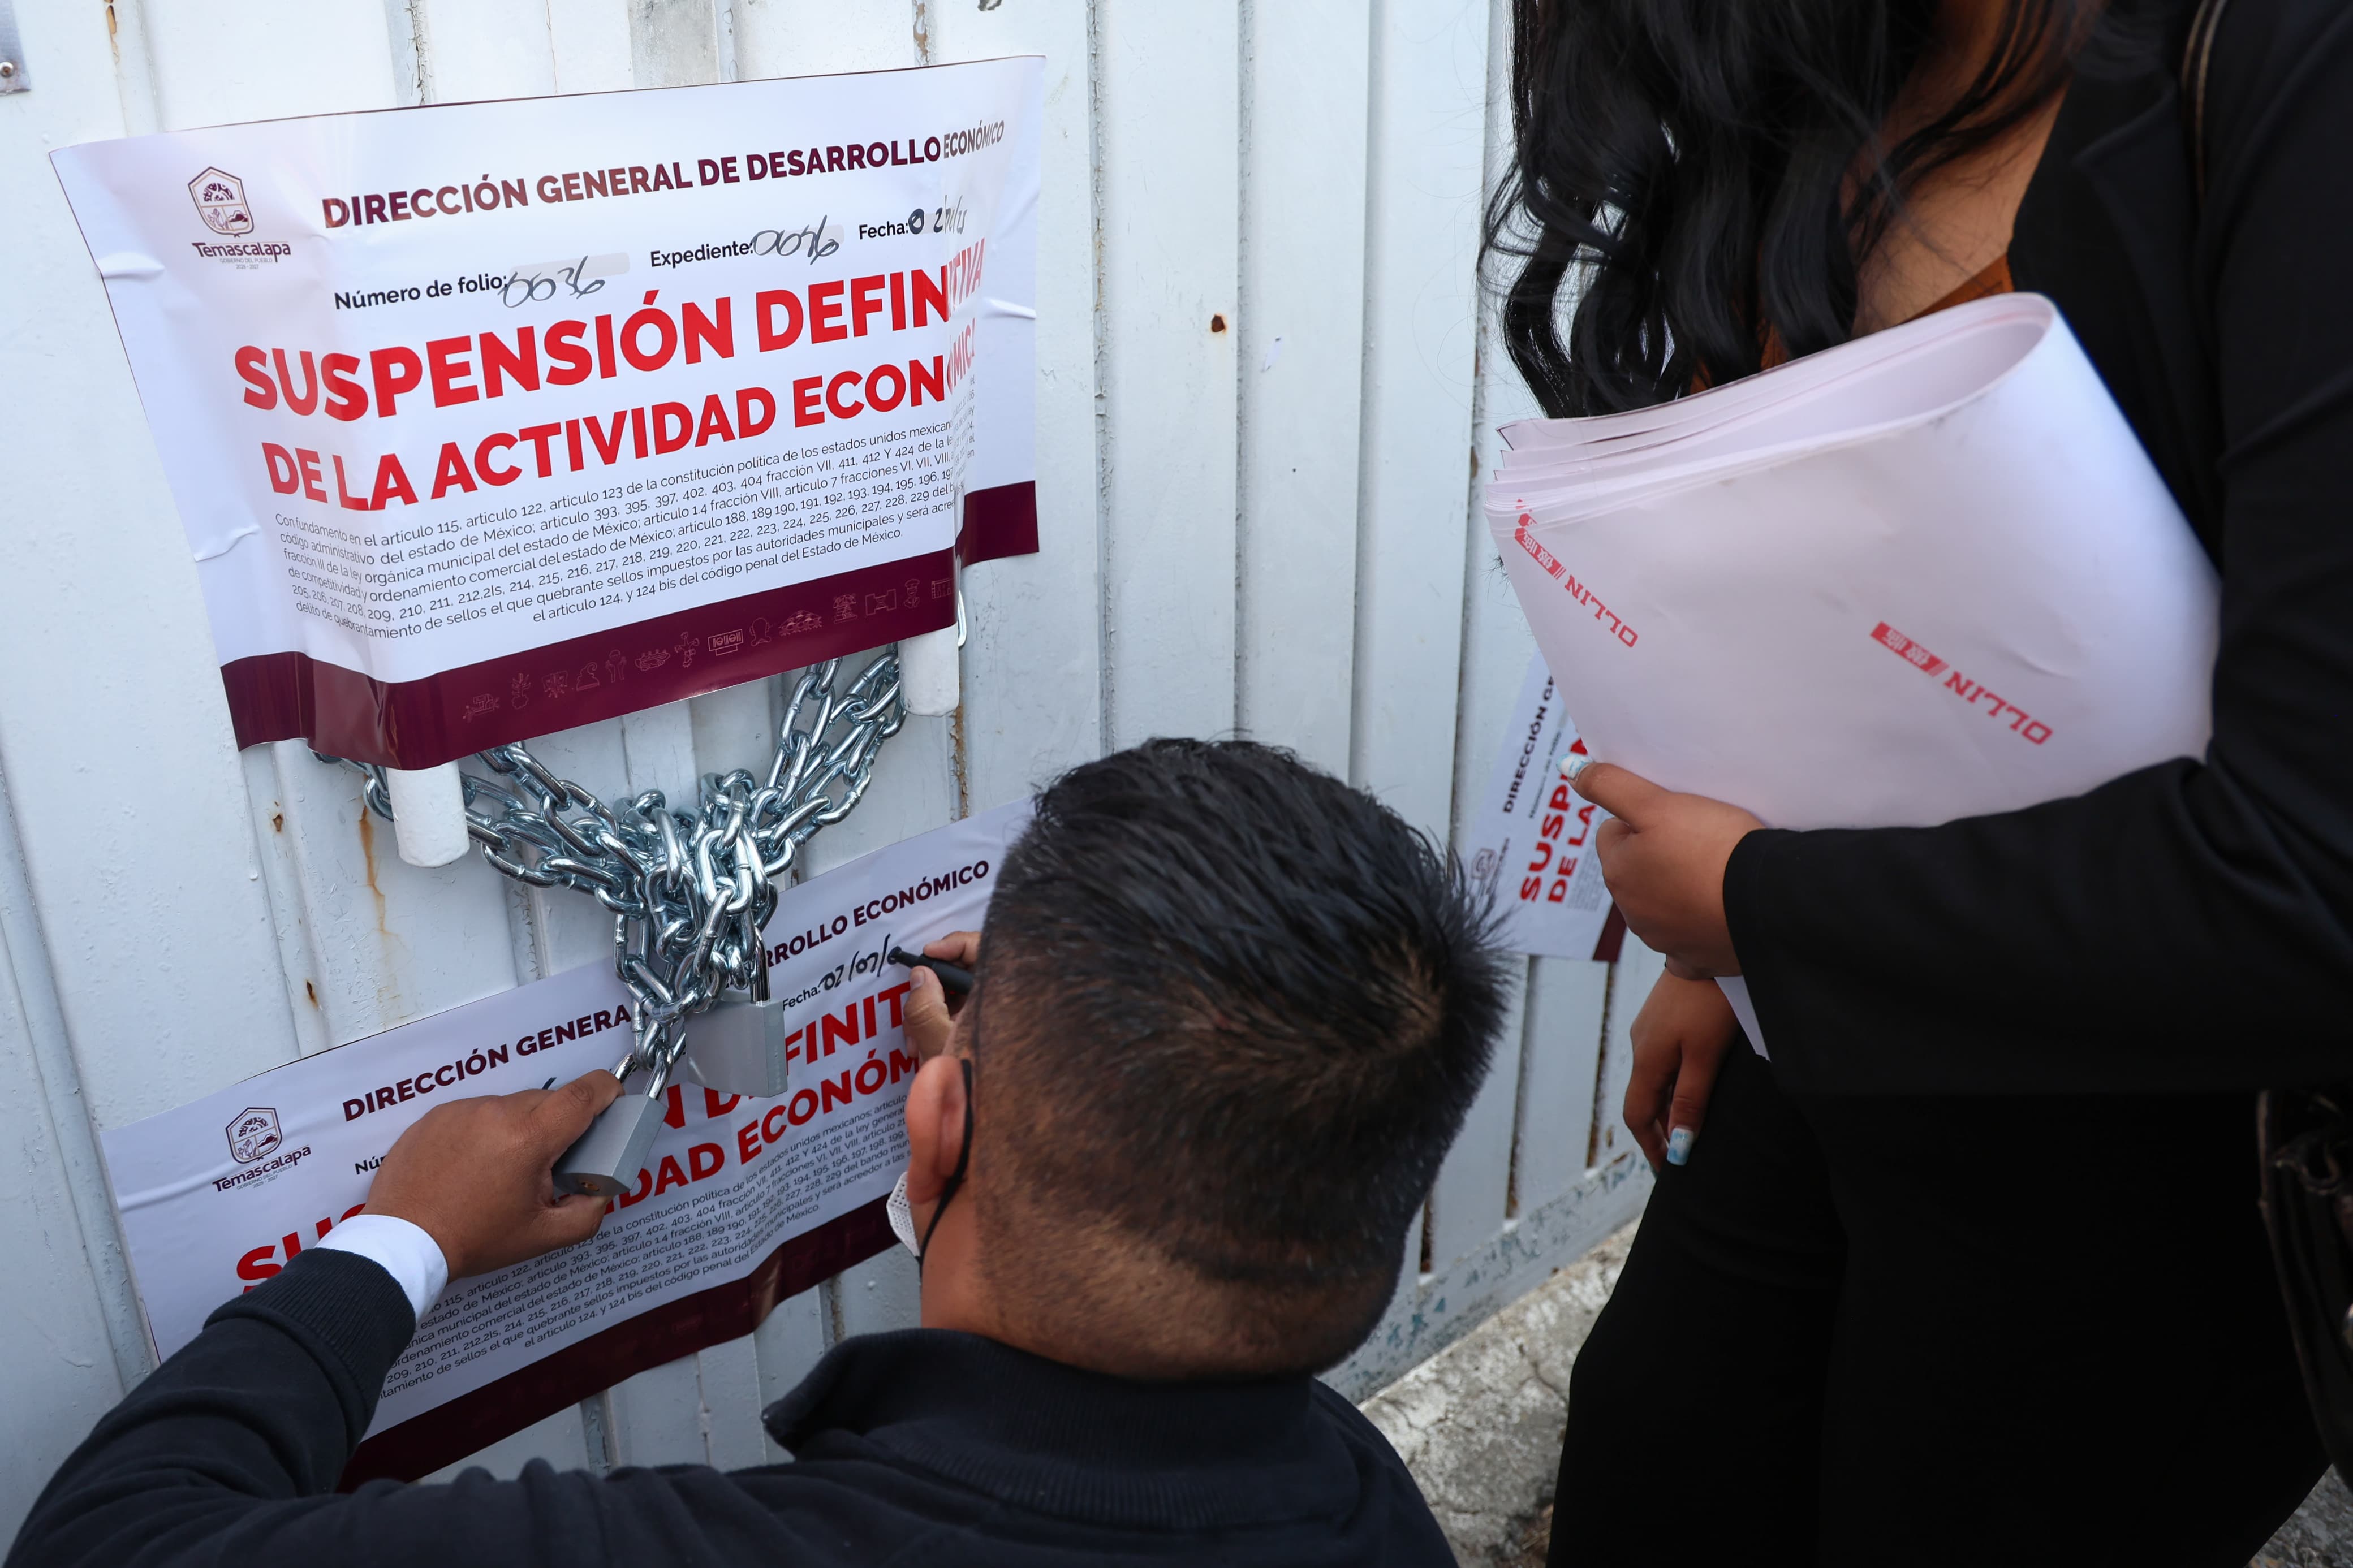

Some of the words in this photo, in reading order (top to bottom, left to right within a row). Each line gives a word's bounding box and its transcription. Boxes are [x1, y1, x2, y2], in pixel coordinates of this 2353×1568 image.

[322, 174, 528, 229] DIRECCIÓN
[537, 162, 692, 204] GENERAL
[699, 155, 740, 186] DE
[746, 136, 941, 180] DESARROLLO
[943, 119, 1005, 159] ECONÓMICO
[191, 242, 291, 262] Temascalapa
[650, 238, 753, 267] Expediente:
[859, 221, 908, 240] Fecha:
[334, 285, 421, 310] Número
[426, 280, 453, 297] de
[458, 274, 507, 294] folio:
[234, 290, 734, 422] SUSPENSIÓN
[261, 442, 328, 504] DE
[333, 453, 419, 511] LA
[431, 386, 778, 501] ACTIVIDAD
[275, 513, 295, 528] Con
[296, 517, 347, 542] fundamento
[350, 534, 361, 546] en
[364, 534, 378, 546] el
[437, 520, 462, 533] 115,
[521, 503, 546, 516] 122,
[602, 487, 623, 499] 123
[627, 482, 643, 494] de
[647, 478, 657, 490] la
[661, 463, 734, 487] constitución
[783, 450, 798, 461] de
[801, 448, 818, 459] los
[822, 438, 866, 454] estados
[870, 431, 906, 446] unidos
[327, 561, 338, 574] de
[340, 563, 348, 577] la
[350, 566, 361, 585] ley
[365, 567, 424, 586] orgánica
[499, 542, 520, 558] del
[524, 534, 568, 552] estado
[572, 529, 589, 541] de
[593, 519, 640, 537] México;
[692, 504, 707, 515] 1.4
[710, 493, 757, 511] fracción
[760, 487, 781, 500] VIII,
[785, 478, 828, 495] articulo
[841, 465, 898, 484] fracciones
[916, 456, 932, 468] VII,
[934, 452, 950, 464] VIII,
[380, 550, 405, 564] del
[408, 539, 455, 559] estado
[460, 534, 479, 547] de
[484, 524, 535, 542] México;
[594, 506, 620, 521] 393,
[625, 499, 650, 515] 395,
[655, 493, 678, 508] 397,
[683, 487, 707, 501] 402,
[712, 481, 736, 495] 403,
[740, 475, 762, 489] 404
[766, 464, 813, 482] fracción
[817, 459, 834, 472] VII,
[839, 457, 858, 469] 411,
[863, 452, 880, 464] 412
[884, 448, 891, 459] Y
[895, 445, 913, 458] 424
[918, 441, 932, 452] de
[936, 438, 944, 448] la
[533, 609, 546, 622] el
[600, 593, 623, 606] 124,
[626, 590, 633, 603] y
[636, 584, 656, 597] 124
[659, 578, 676, 591] bis
[679, 572, 699, 586] del
[701, 565, 742, 580] código
[746, 554, 779, 574] penal
[781, 549, 800, 563] del
[803, 541, 841, 558] Estado
[844, 537, 859, 548] de
[1564, 575, 1639, 648] OLLIN
[1945, 671, 2053, 745] OLLIN
[1503, 706, 1548, 813] DIRECCIÓN
[853, 860, 989, 927] ECONÓMICO
[1548, 857, 1578, 903] DE
[1568, 804, 1597, 847] LA
[783, 986, 821, 1010] Fecha:
[342, 1048, 509, 1122] DIRECCIÓN
[516, 1005, 632, 1056] GENERA
[212, 1146, 311, 1191] Temascalapa
